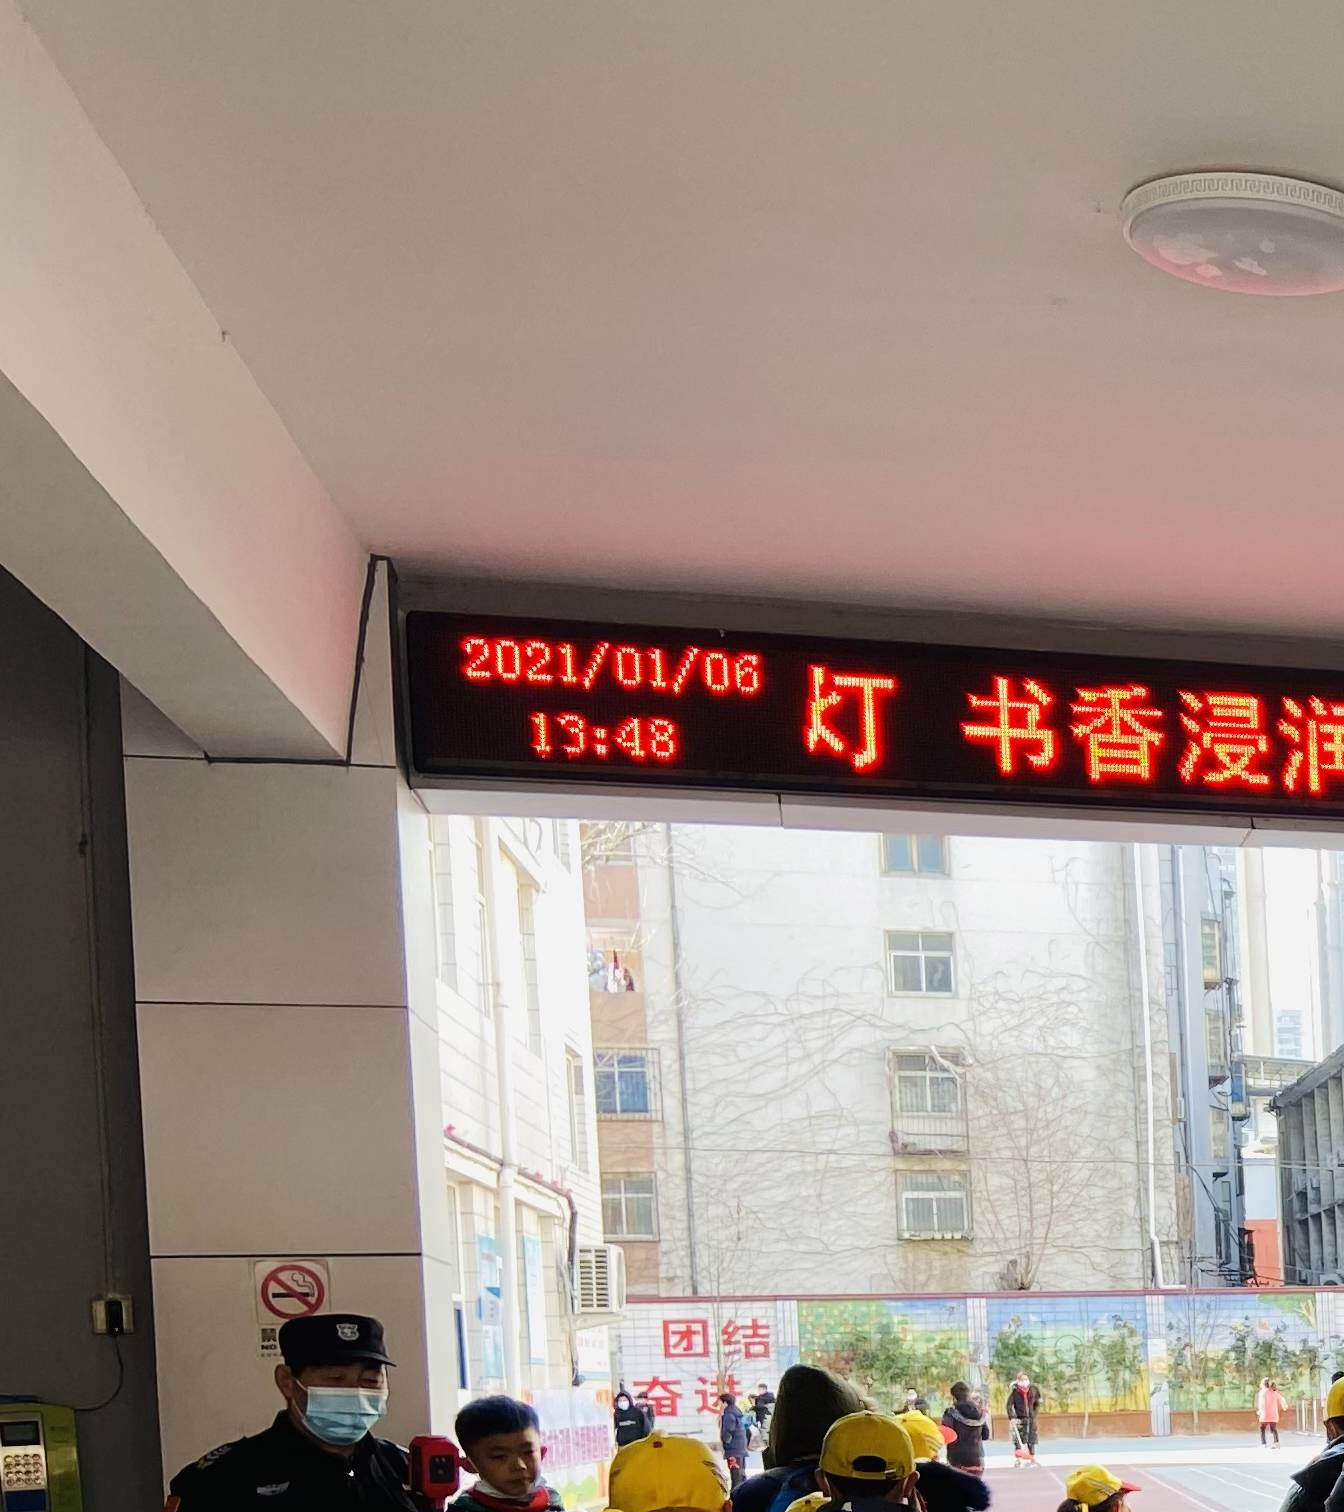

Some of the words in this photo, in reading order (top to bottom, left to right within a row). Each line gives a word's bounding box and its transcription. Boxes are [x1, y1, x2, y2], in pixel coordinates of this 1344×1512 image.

[464, 637, 761, 694] 2021/01/06
[530, 711, 677, 759] 13:48
[807, 664, 896, 769] 灯
[662, 1318, 770, 1360] 团结
